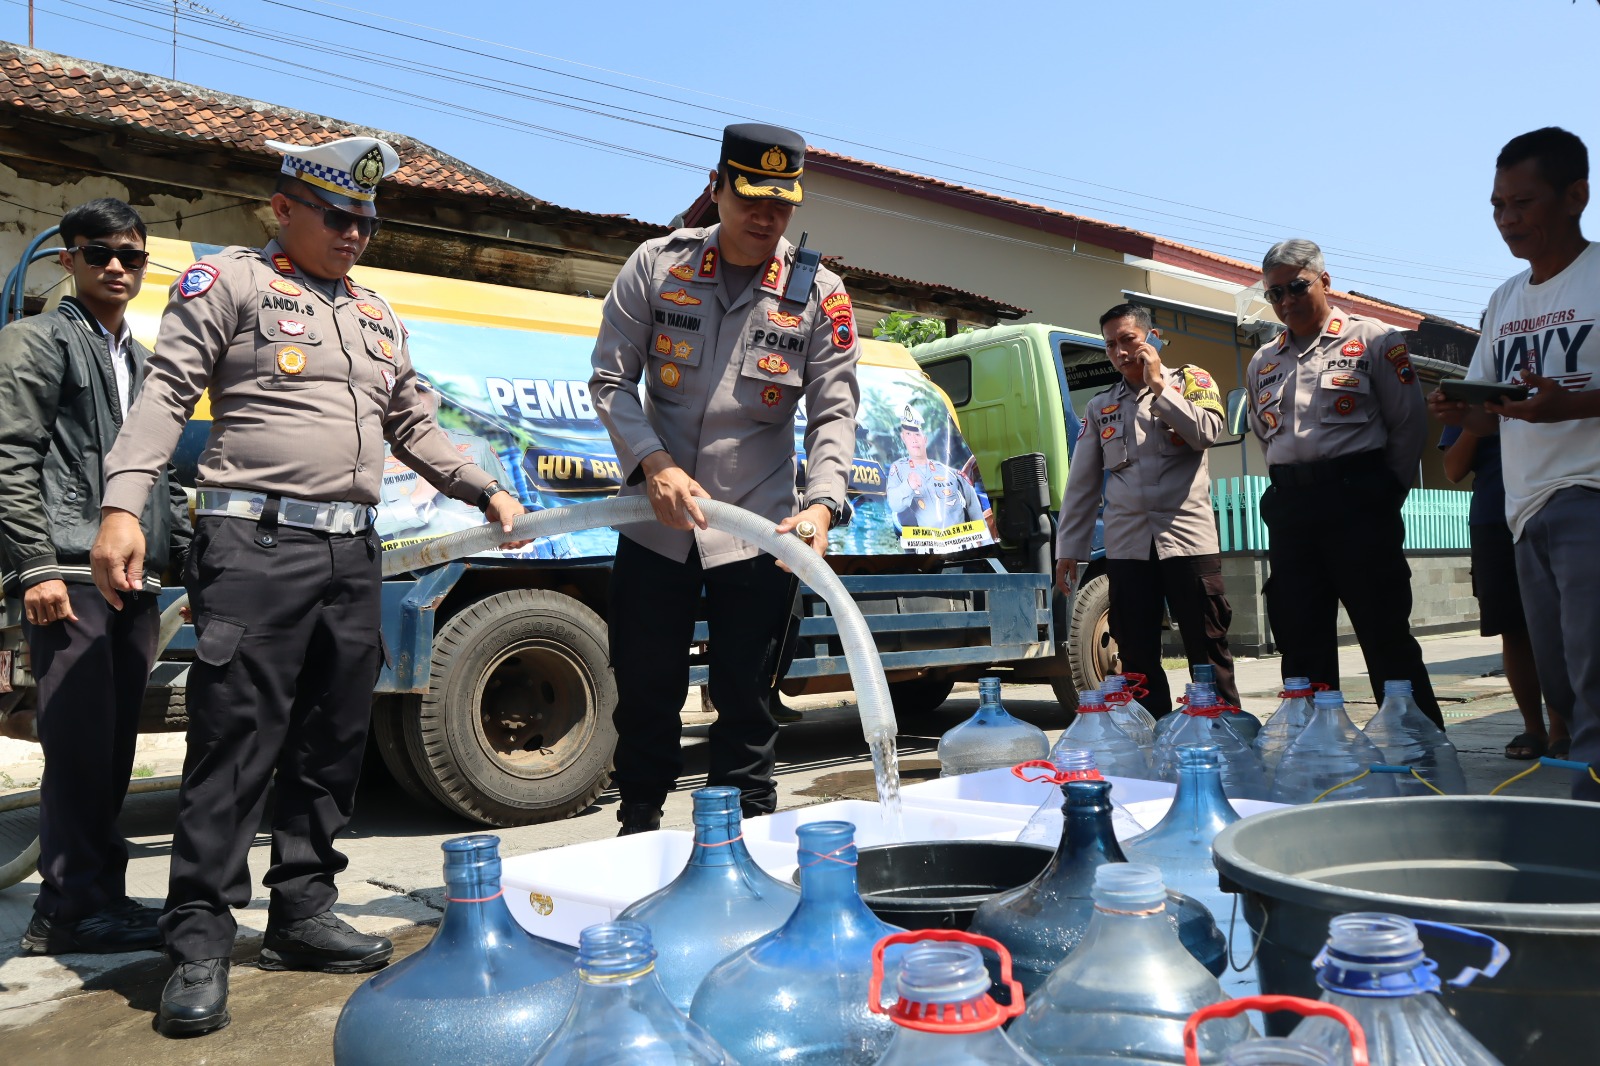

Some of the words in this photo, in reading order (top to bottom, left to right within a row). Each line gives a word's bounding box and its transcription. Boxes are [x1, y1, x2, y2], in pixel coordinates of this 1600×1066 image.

[358, 317, 395, 341] POLRI
[1499, 308, 1576, 336] HEADQUARTERS
[754, 329, 805, 353] POLRI
[1492, 323, 1595, 383] NAVY
[1327, 358, 1370, 371] POLRI
[486, 377, 600, 420] PEMB
[537, 455, 584, 480] HUT
[590, 458, 624, 479] BH
[851, 464, 881, 486] 2026
